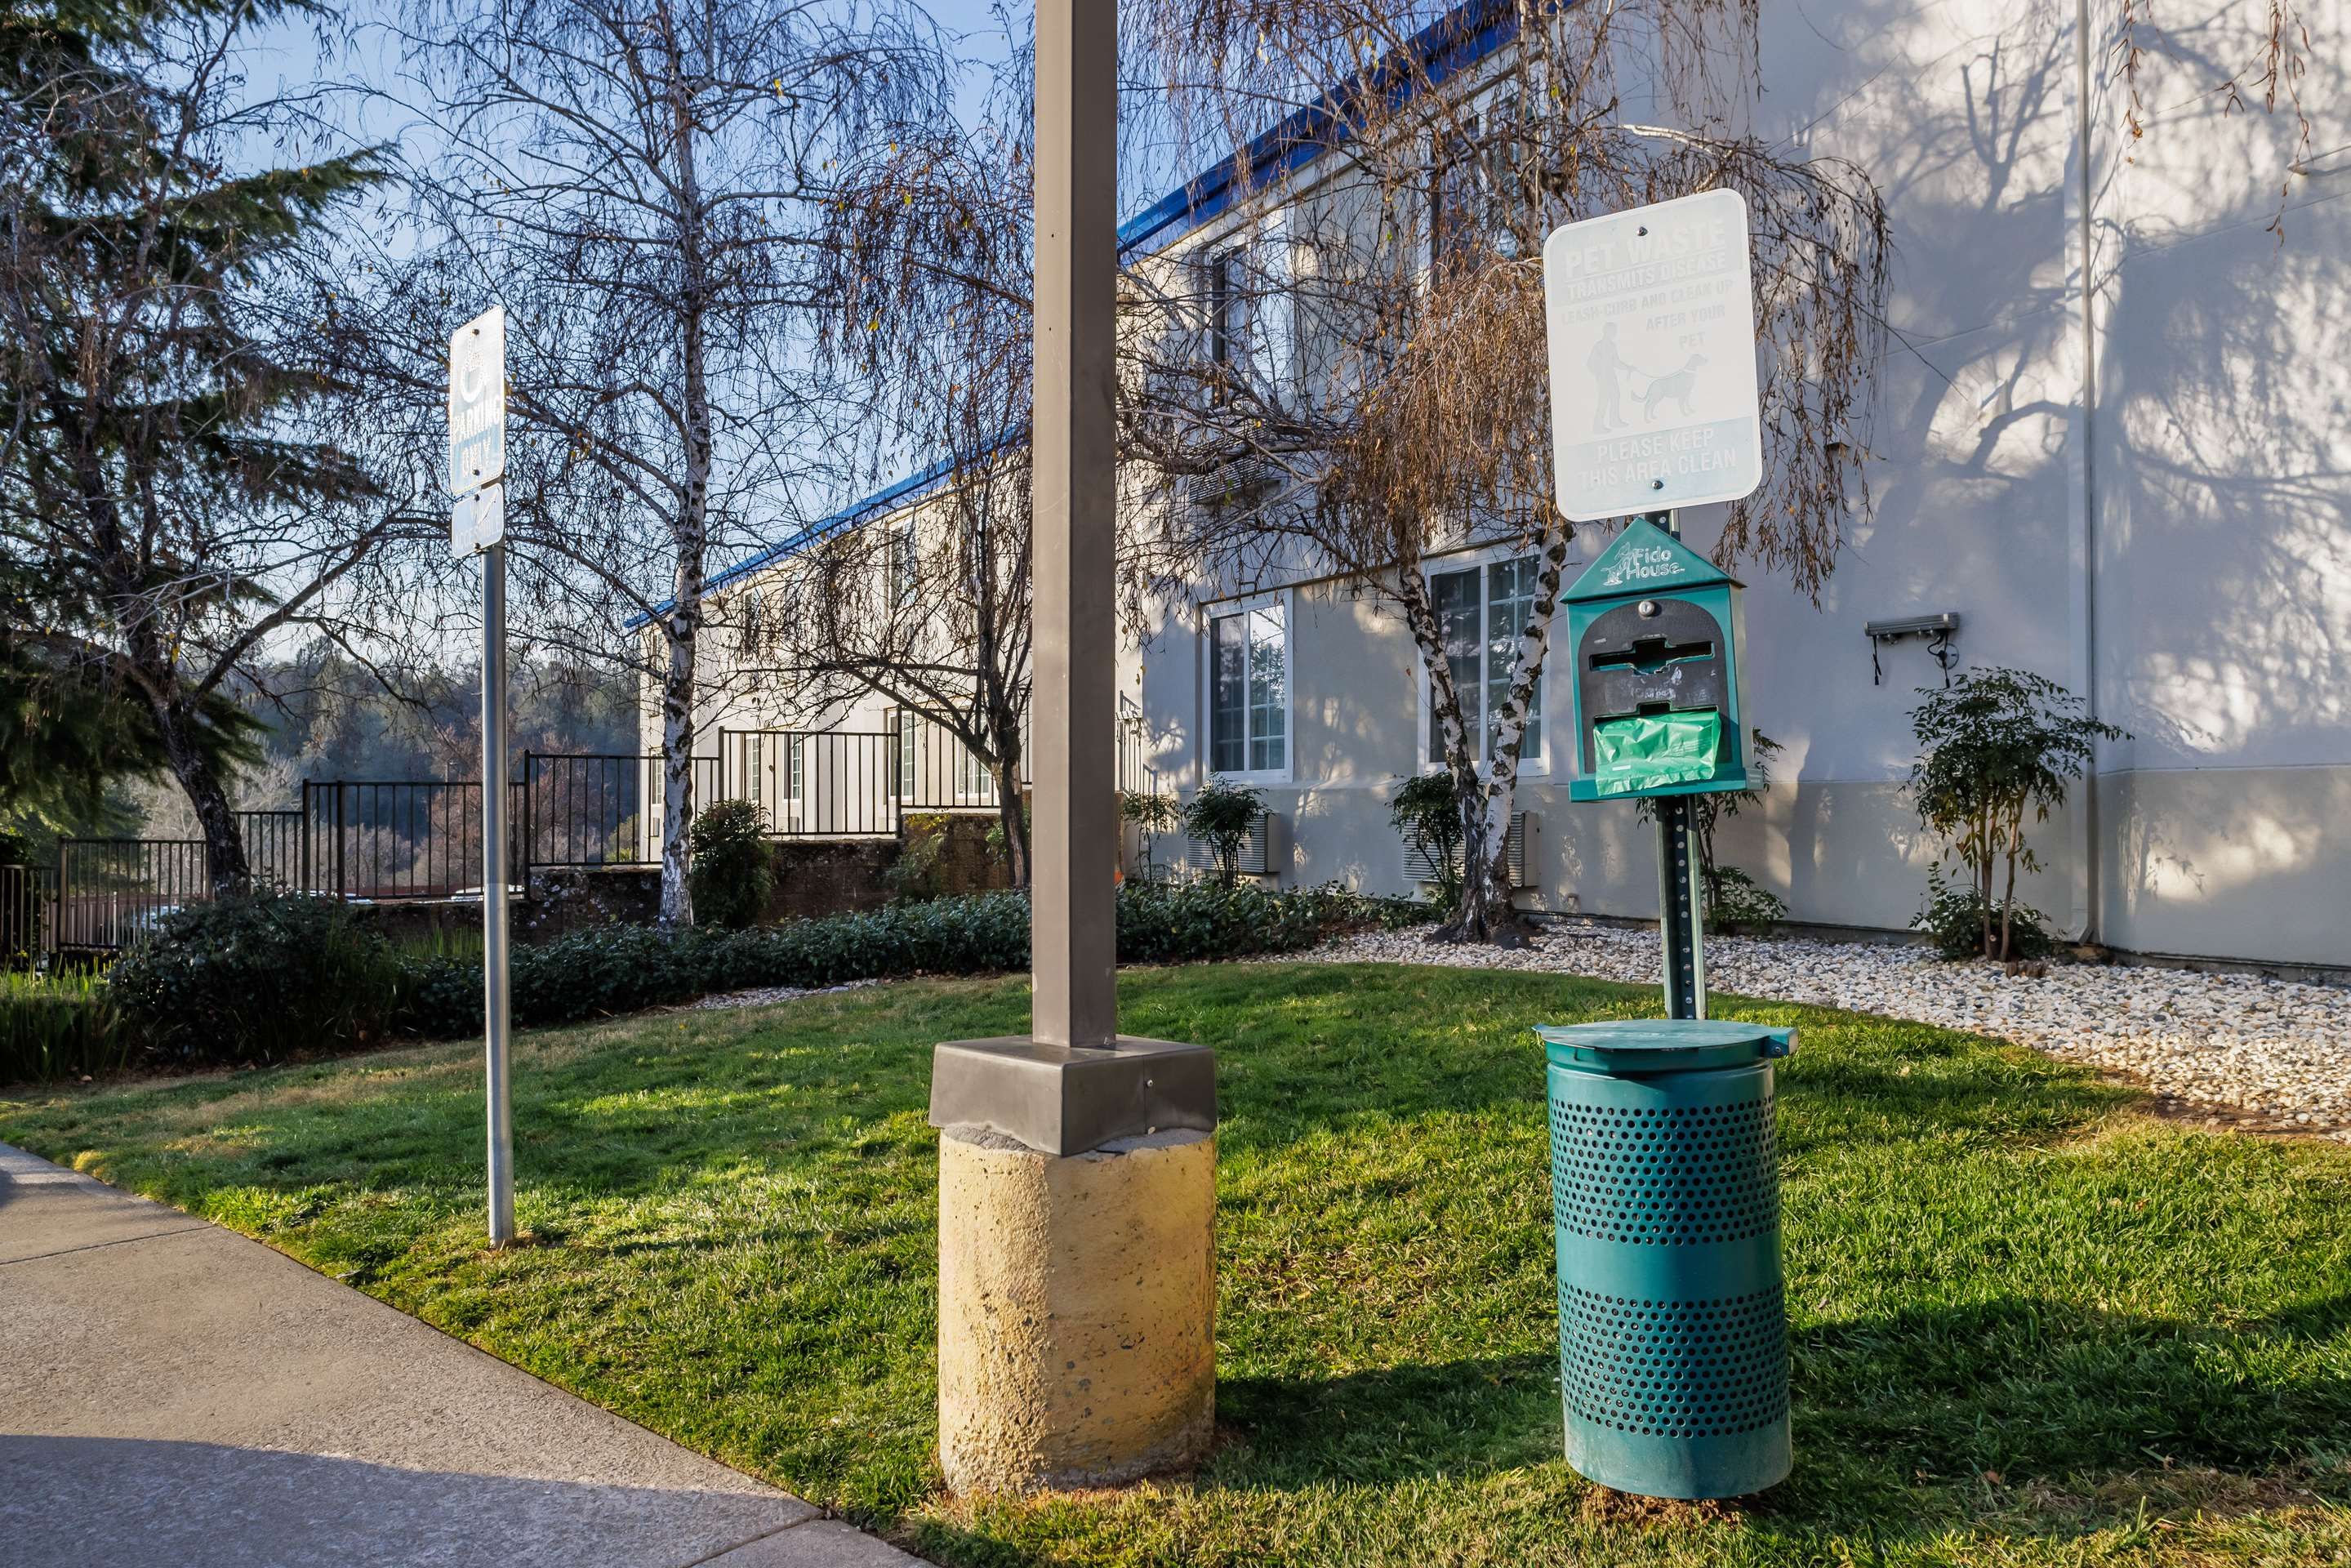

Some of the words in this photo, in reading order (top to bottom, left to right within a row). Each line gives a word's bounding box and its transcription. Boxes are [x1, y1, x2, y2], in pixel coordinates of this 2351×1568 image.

[1564, 242, 1615, 278] PET
[1627, 216, 1725, 264] WASTE
[1568, 266, 1654, 300] TRANSMITS
[1661, 252, 1725, 280] DISEASE
[1641, 292, 1666, 310] AND
[1671, 283, 1712, 303] CLEAN
[1716, 279, 1734, 294] UP
[1645, 312, 1686, 332] AFTER
[1690, 304, 1725, 323] YOUR
[1679, 332, 1705, 349] PET
[452, 394, 501, 445] PARKING
[1597, 435, 1663, 463] PLEASE
[1670, 430, 1714, 452] KEEP
[1578, 466, 1619, 488] THIS
[1626, 458, 1672, 483] AREA
[1678, 448, 1737, 474] CLEAN
[1626, 562, 1685, 580] House
[1632, 546, 1672, 565] Fido
